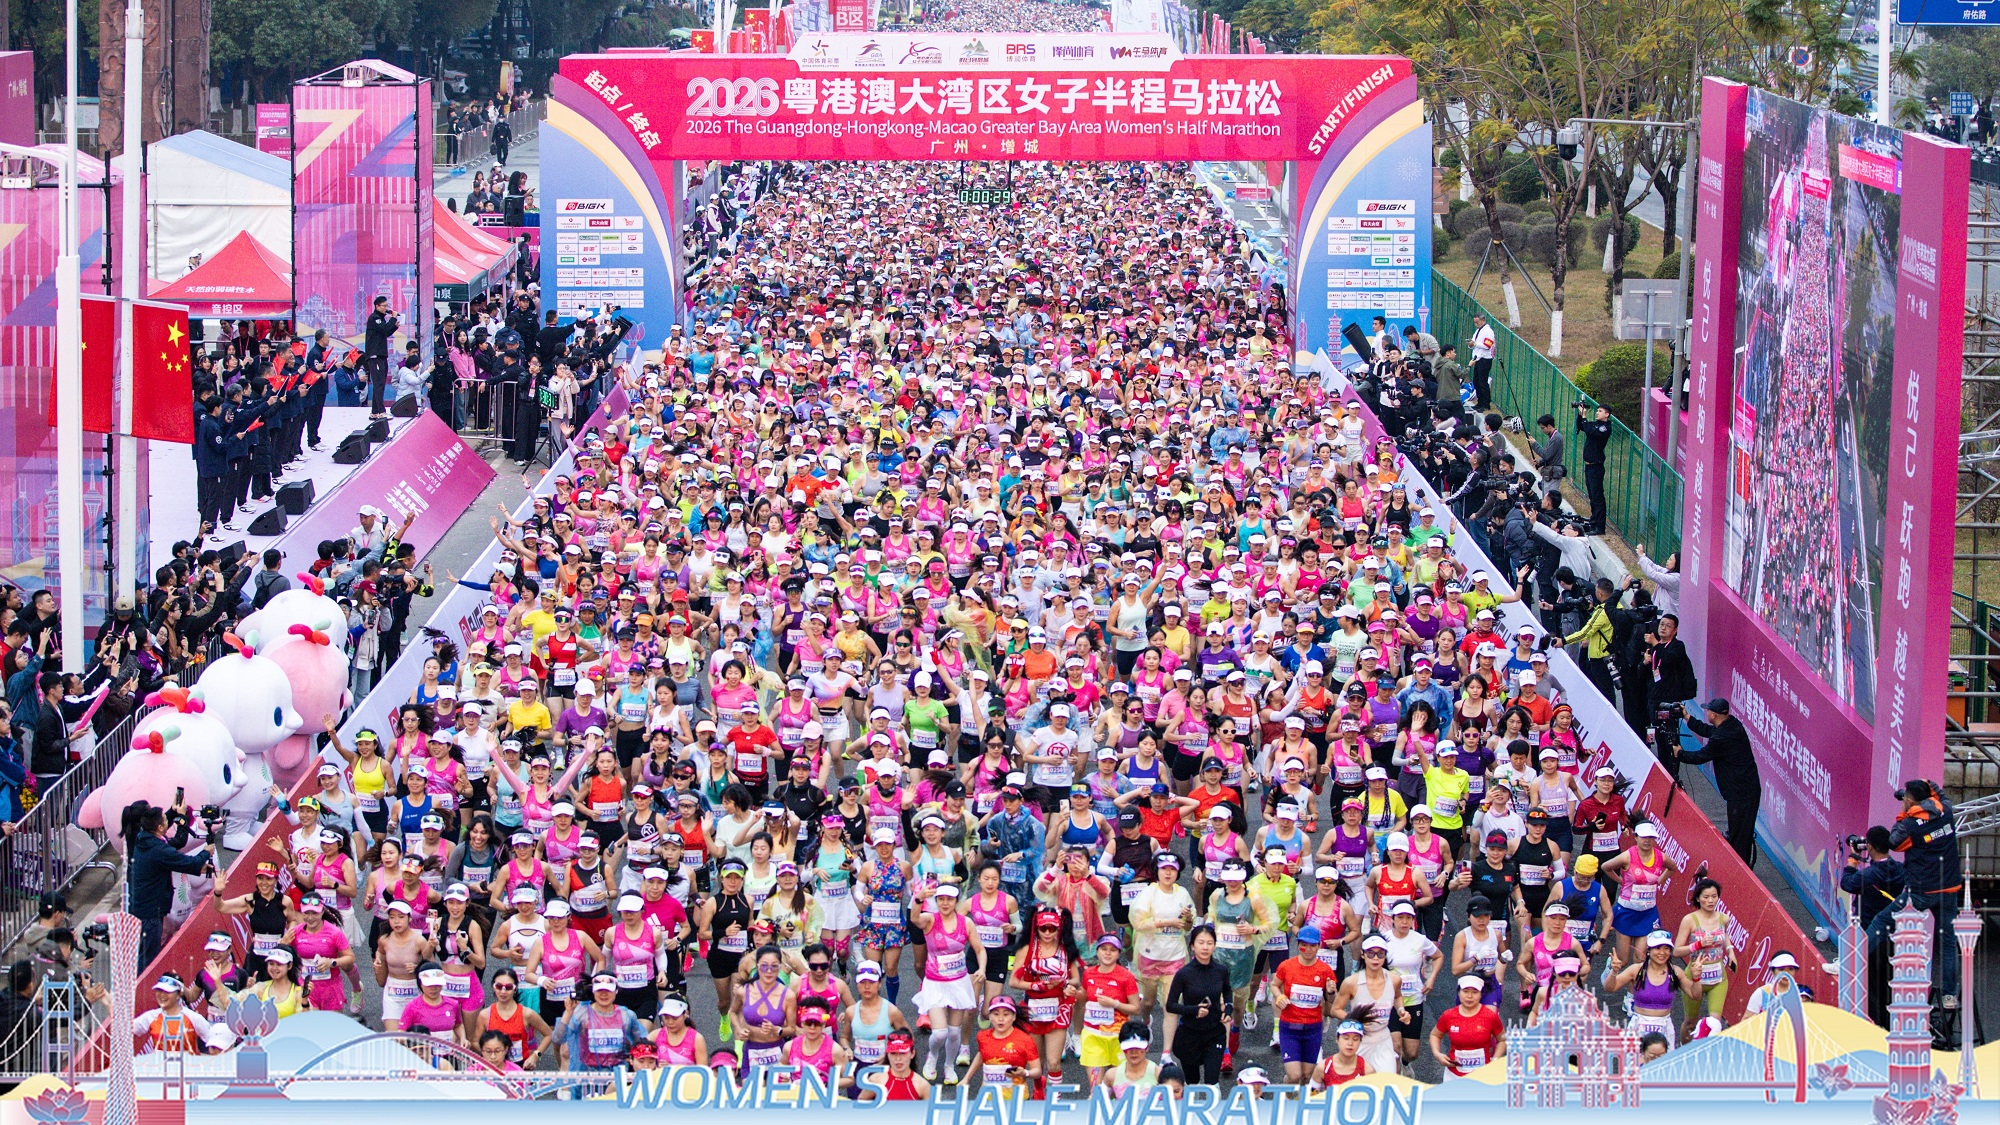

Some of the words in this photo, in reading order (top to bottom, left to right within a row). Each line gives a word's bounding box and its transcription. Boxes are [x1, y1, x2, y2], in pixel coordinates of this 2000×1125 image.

[836, 12, 863, 26] B区
[1963, 10, 1986, 20] 府佑路
[1006, 44, 1035, 54] BRS
[1308, 64, 1394, 155] START/FINISH
[686, 120, 722, 134] 2026
[725, 119, 755, 134] The
[758, 119, 976, 138] Guangdong-Hongkong-Macao
[980, 120, 1035, 135] Greater
[1039, 120, 1066, 138] Bay
[1069, 120, 1102, 135] Area
[1105, 120, 1174, 135] Women's
[1177, 120, 1207, 135] Half
[1210, 120, 1281, 136] Marathon
[961, 190, 1010, 203] 0:00:29
[185, 286, 255, 294] 天然的弱碱性水
[211, 304, 243, 314] 音控区
[1664, 836, 1690, 874] AIRLINES
